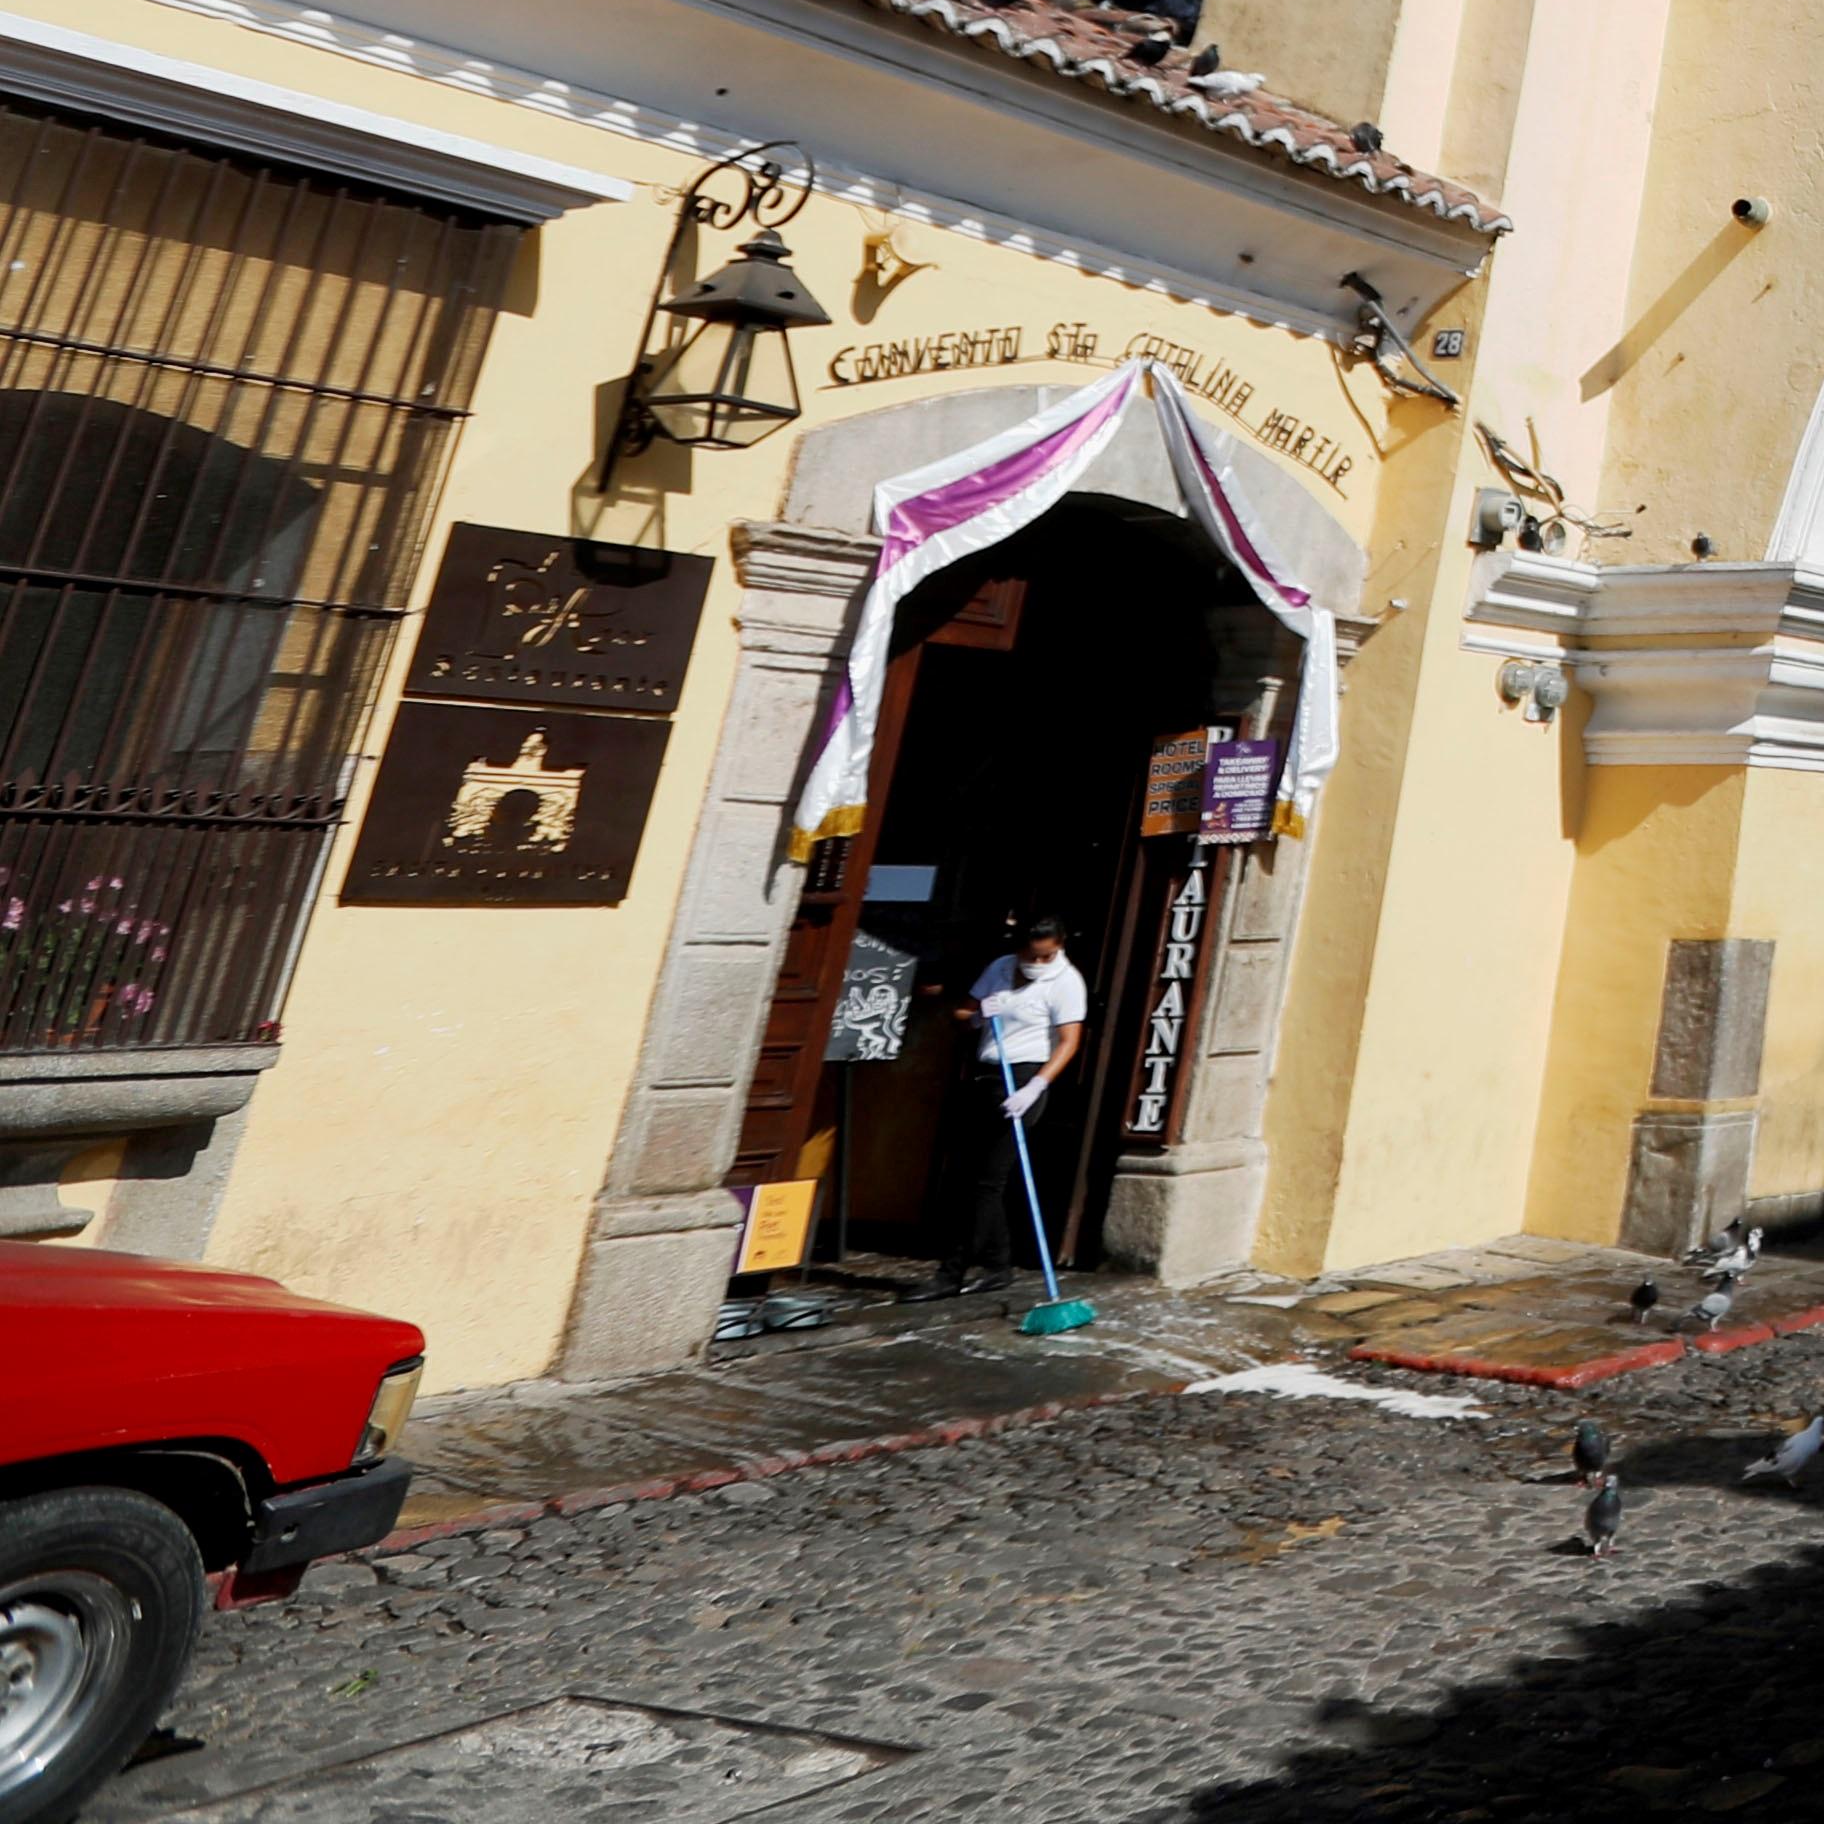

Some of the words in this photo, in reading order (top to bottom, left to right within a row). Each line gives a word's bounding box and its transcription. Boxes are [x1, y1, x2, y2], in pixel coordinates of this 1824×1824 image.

[1435, 332, 1462, 355] 28
[828, 325, 1023, 386] CONVENTO
[1154, 739, 1206, 757] HOTEL
[1150, 759, 1206, 777] ROOMS
